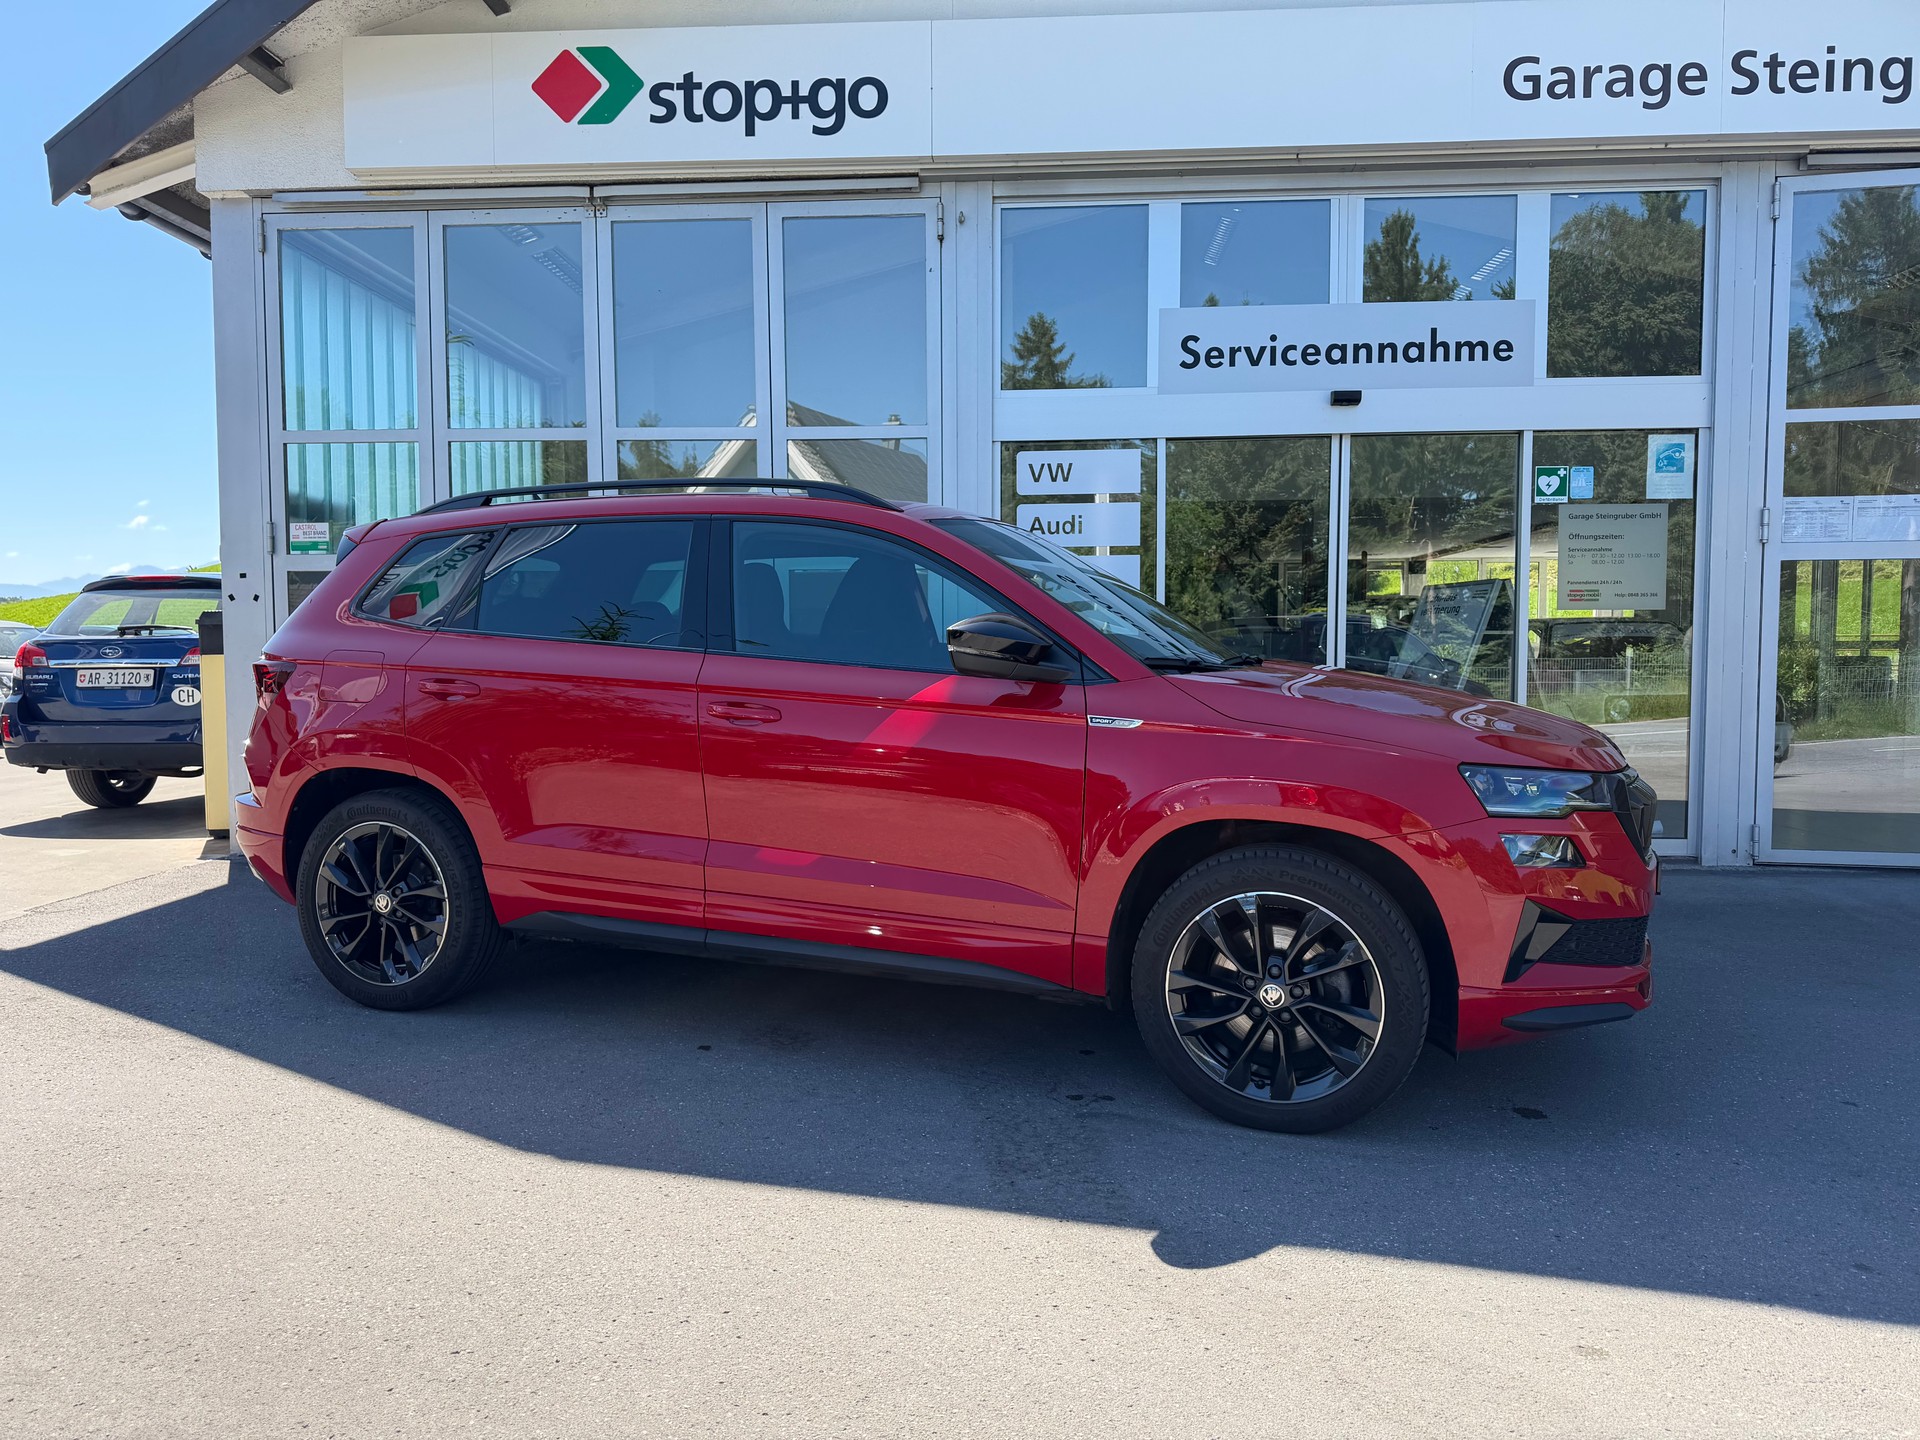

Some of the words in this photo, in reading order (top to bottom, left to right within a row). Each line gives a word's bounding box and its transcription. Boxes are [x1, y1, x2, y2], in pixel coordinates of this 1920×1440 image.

[1502, 56, 1708, 110] Garage
[1731, 45, 1913, 104] Steing
[649, 71, 888, 137] stop+go
[1179, 327, 1514, 370] Serviceannahme
[1028, 462, 1073, 483] VW
[1029, 515, 1083, 535] Audi
[1568, 513, 1594, 521] Garage
[1596, 512, 1637, 521] Steingruber
[1568, 533, 1625, 541] Öffnungszeiten:
[178, 689, 195, 703] CH
